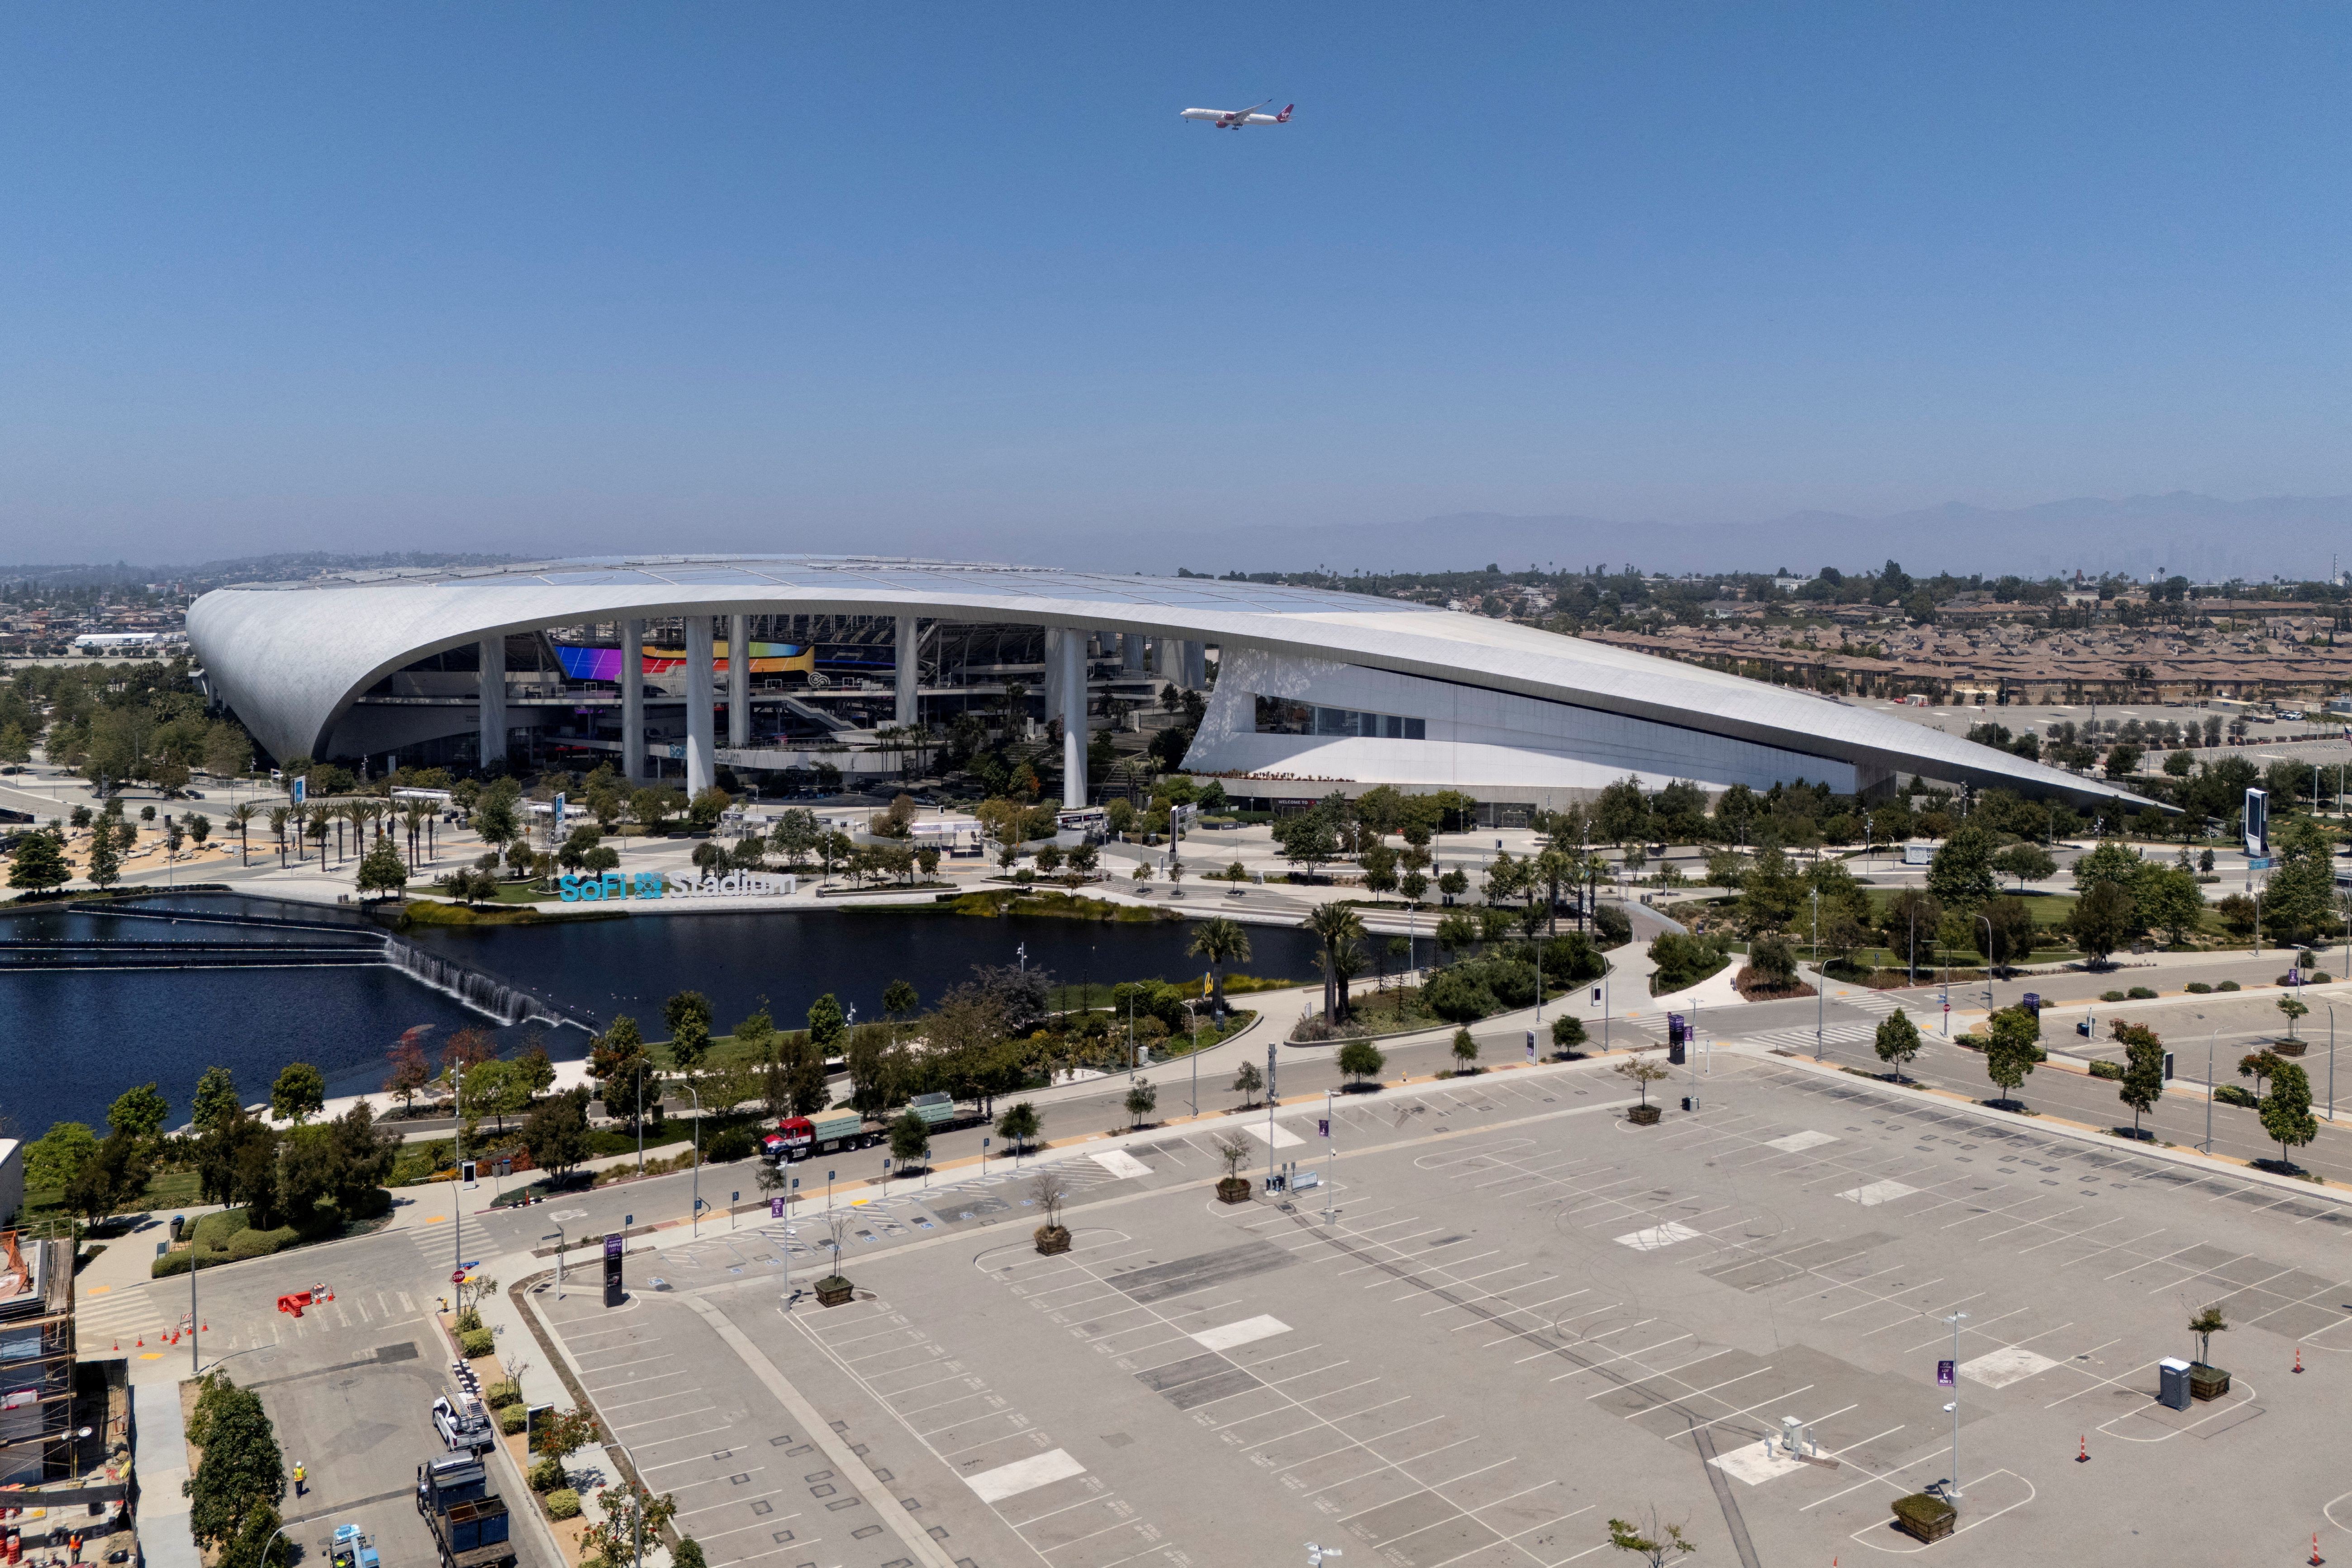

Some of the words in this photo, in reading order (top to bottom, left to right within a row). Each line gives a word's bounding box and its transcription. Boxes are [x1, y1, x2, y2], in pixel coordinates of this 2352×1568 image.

[670, 744, 687, 758] SoF
[560, 873, 627, 902] SoFi
[669, 869, 796, 898] Stadium
